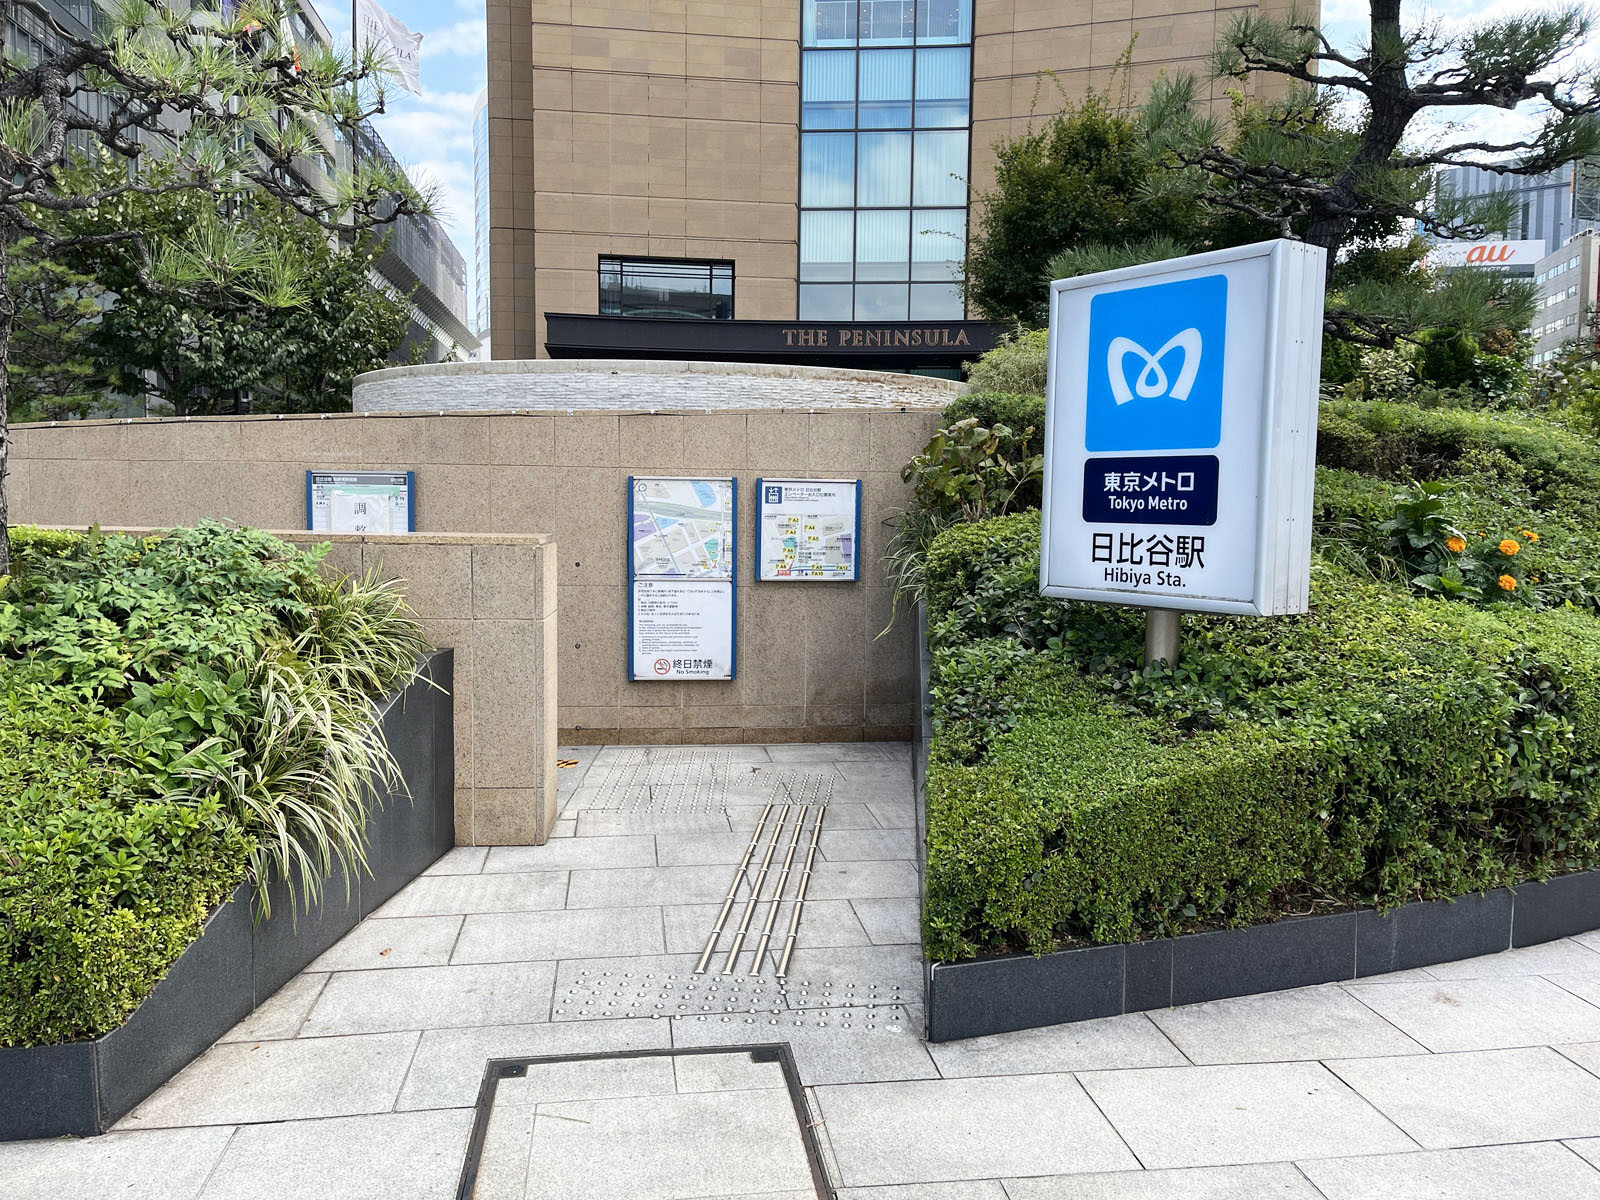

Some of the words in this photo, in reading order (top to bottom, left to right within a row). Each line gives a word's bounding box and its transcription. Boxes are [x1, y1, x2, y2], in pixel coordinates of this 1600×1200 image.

[1466, 244, 1516, 262] au
[782, 330, 828, 346] THE
[838, 328, 971, 346] PENINSULA
[1104, 472, 1194, 492] 東京メトロ
[1108, 496, 1145, 512] Tokyo
[1148, 496, 1188, 510] Metro
[1092, 532, 1205, 569] 日比谷駅
[1104, 568, 1151, 588] Hibiya
[1157, 570, 1186, 587] Sta.
[672, 659, 713, 669] 終日禁煙
